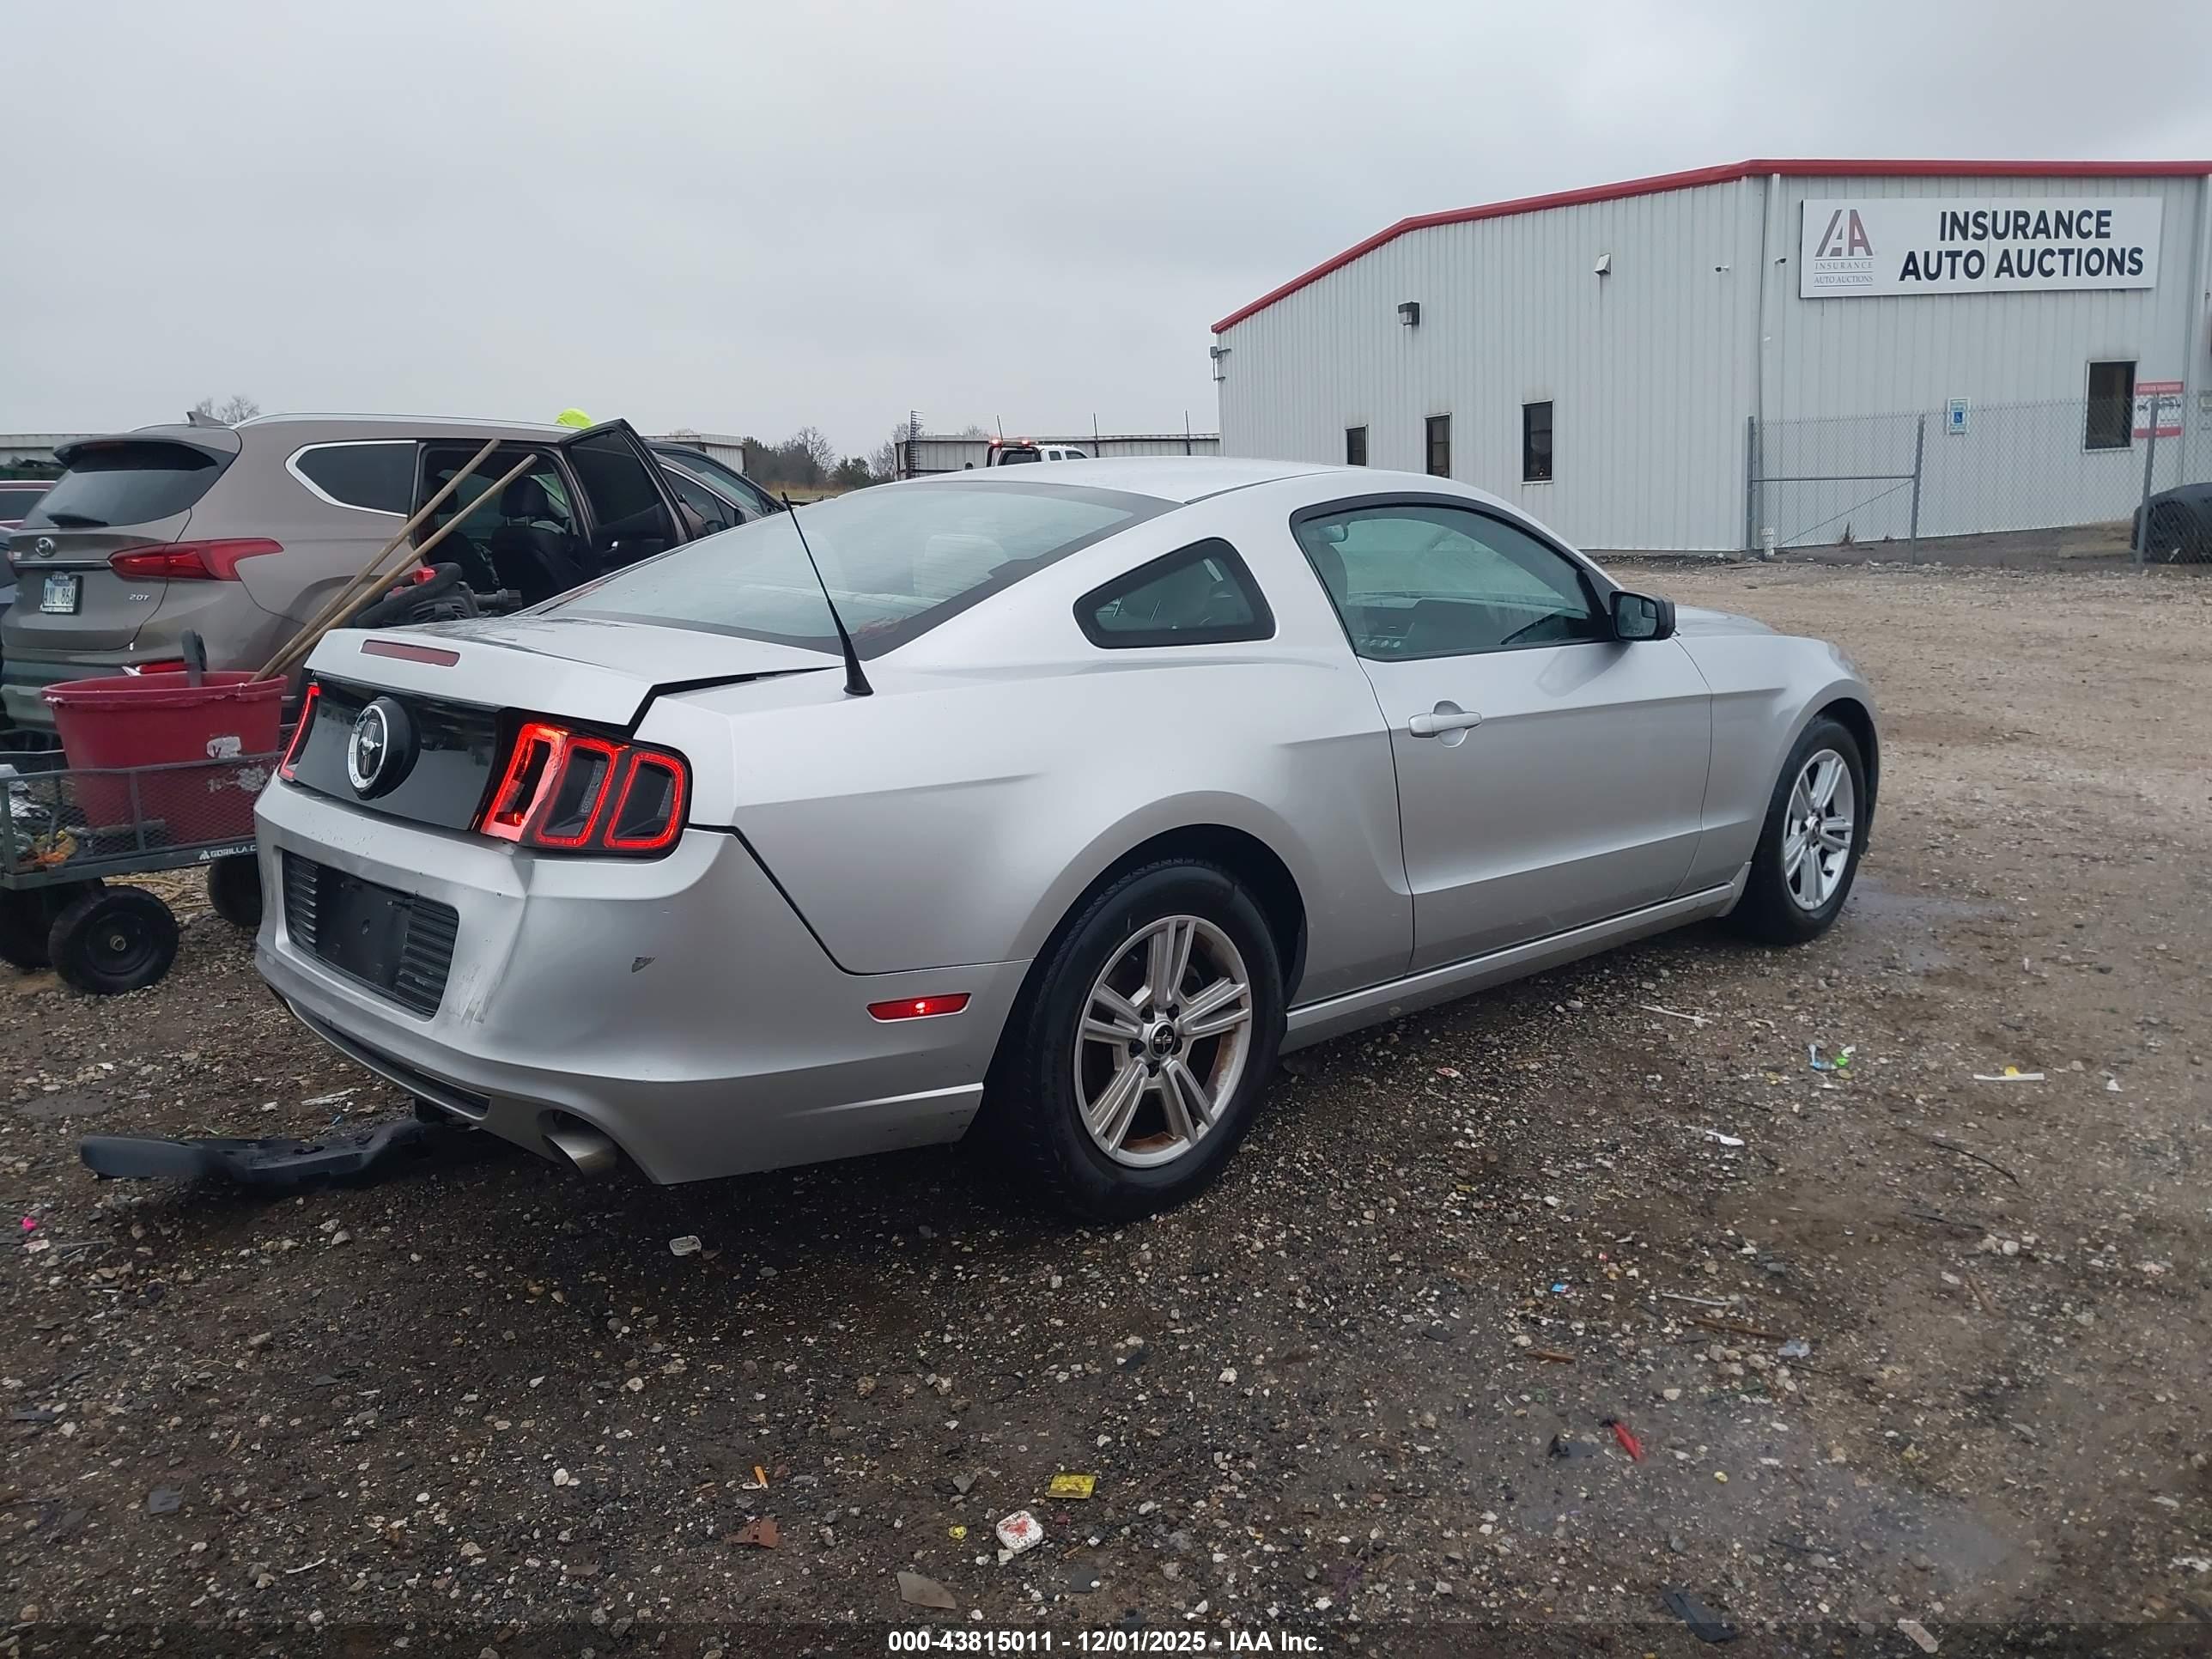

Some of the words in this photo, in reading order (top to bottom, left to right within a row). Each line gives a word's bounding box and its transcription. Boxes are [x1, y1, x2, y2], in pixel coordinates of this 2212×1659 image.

[1939, 210, 2112, 241] INSURANCE
[1814, 261, 1873, 270] INSURANCE
[1899, 249, 1985, 282] AUTO
[1994, 246, 2144, 279] AUCTIONS
[1814, 276, 1835, 284] AUTO
[1835, 275, 1874, 283] AUCTIONS
[210, 846, 248, 858] GORILLA
